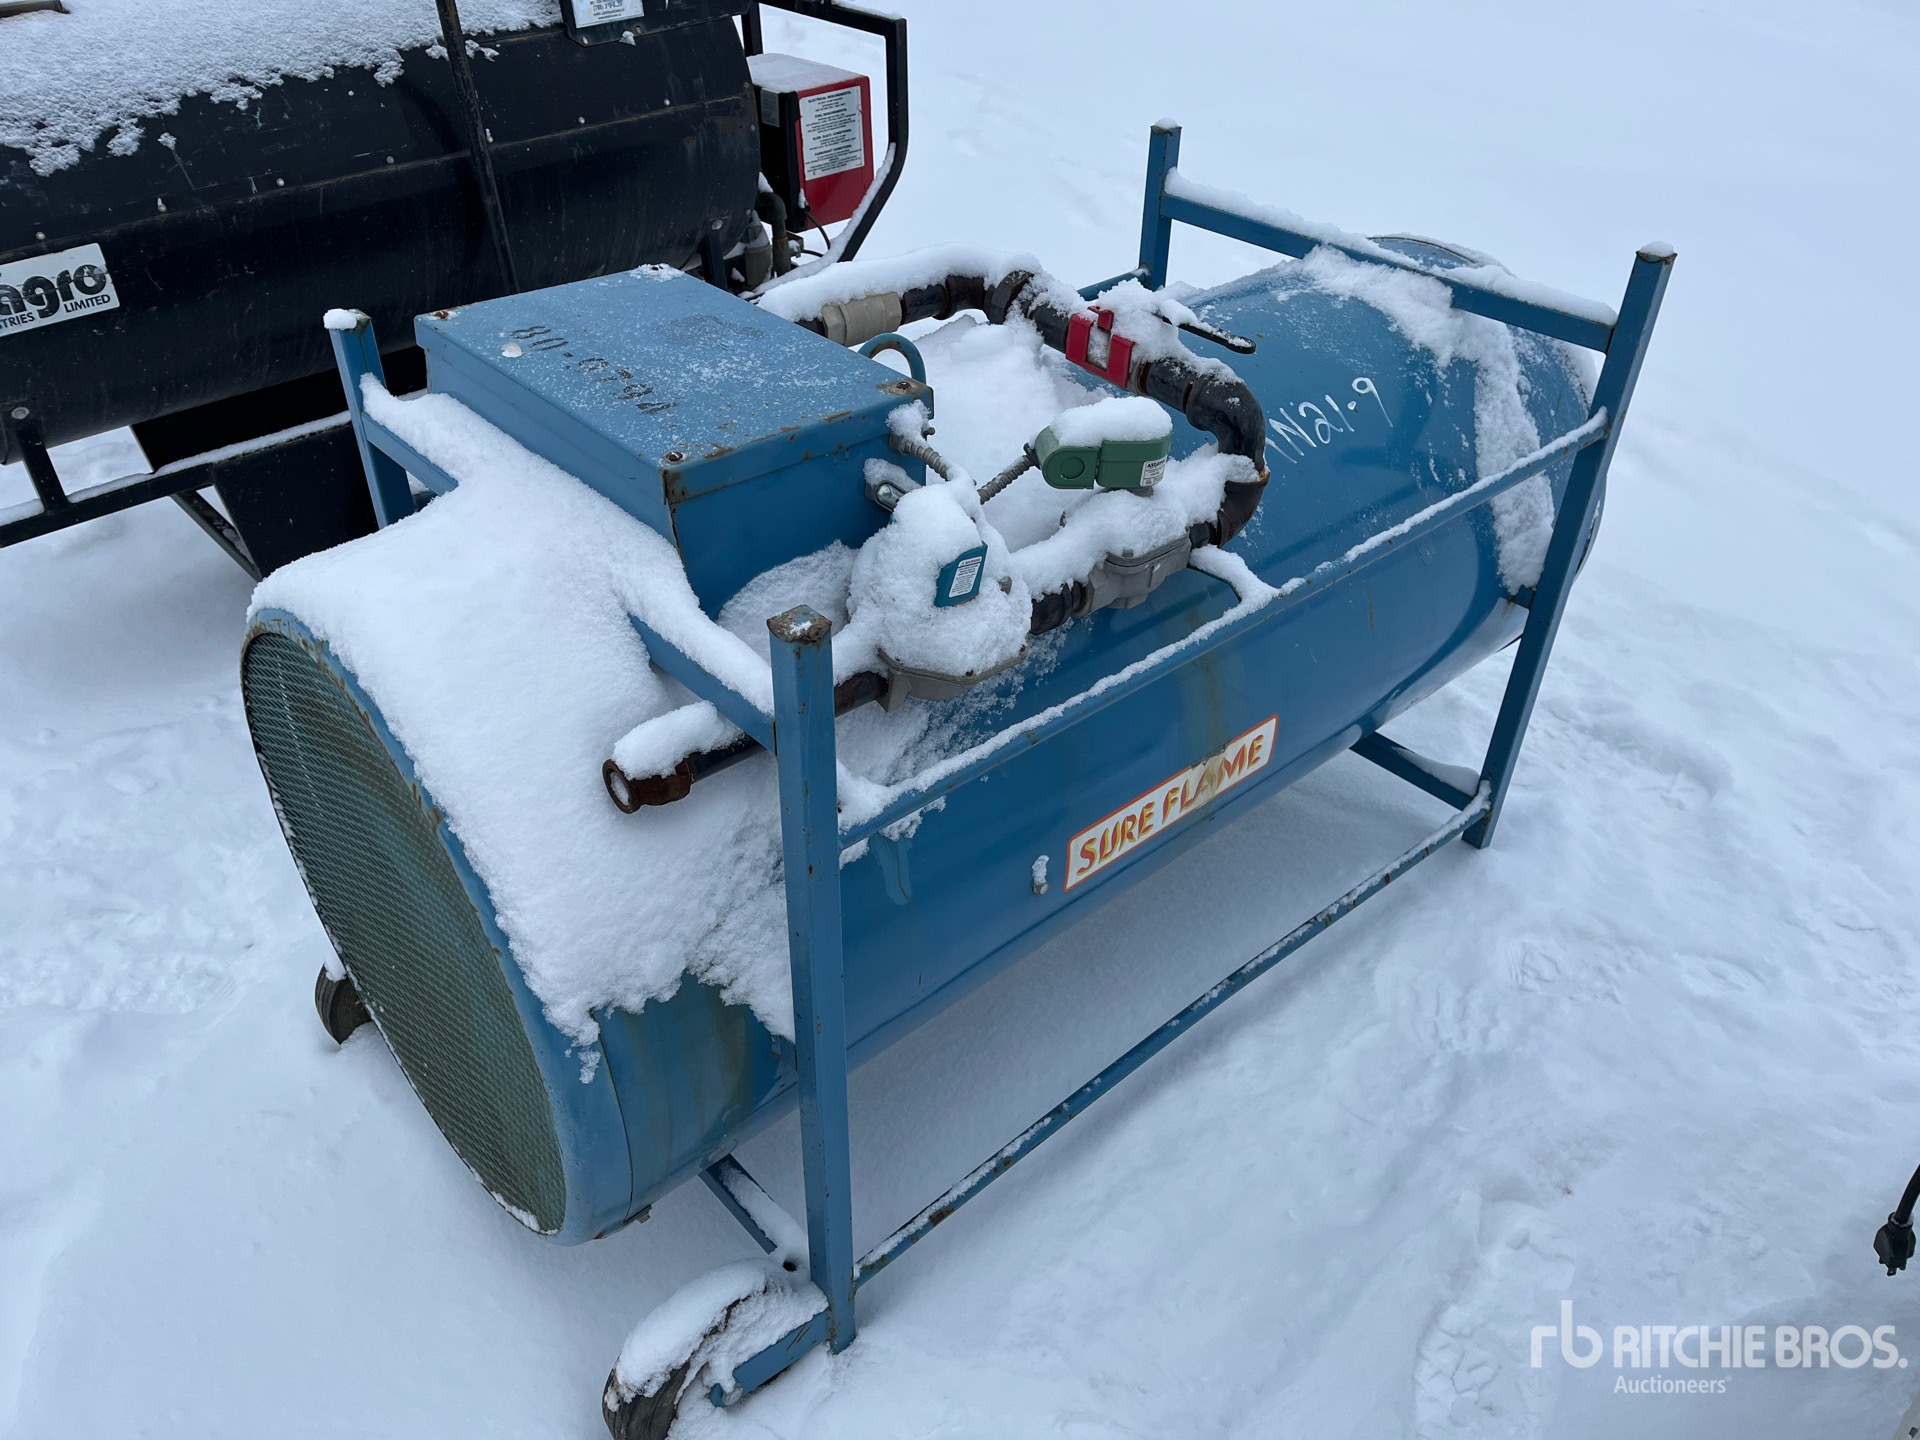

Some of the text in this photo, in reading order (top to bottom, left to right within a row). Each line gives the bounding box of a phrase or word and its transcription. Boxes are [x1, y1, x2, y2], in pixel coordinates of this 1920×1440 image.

[64, 294, 111, 313] LIMITED
[1076, 734, 1265, 876] SURE FLAME
